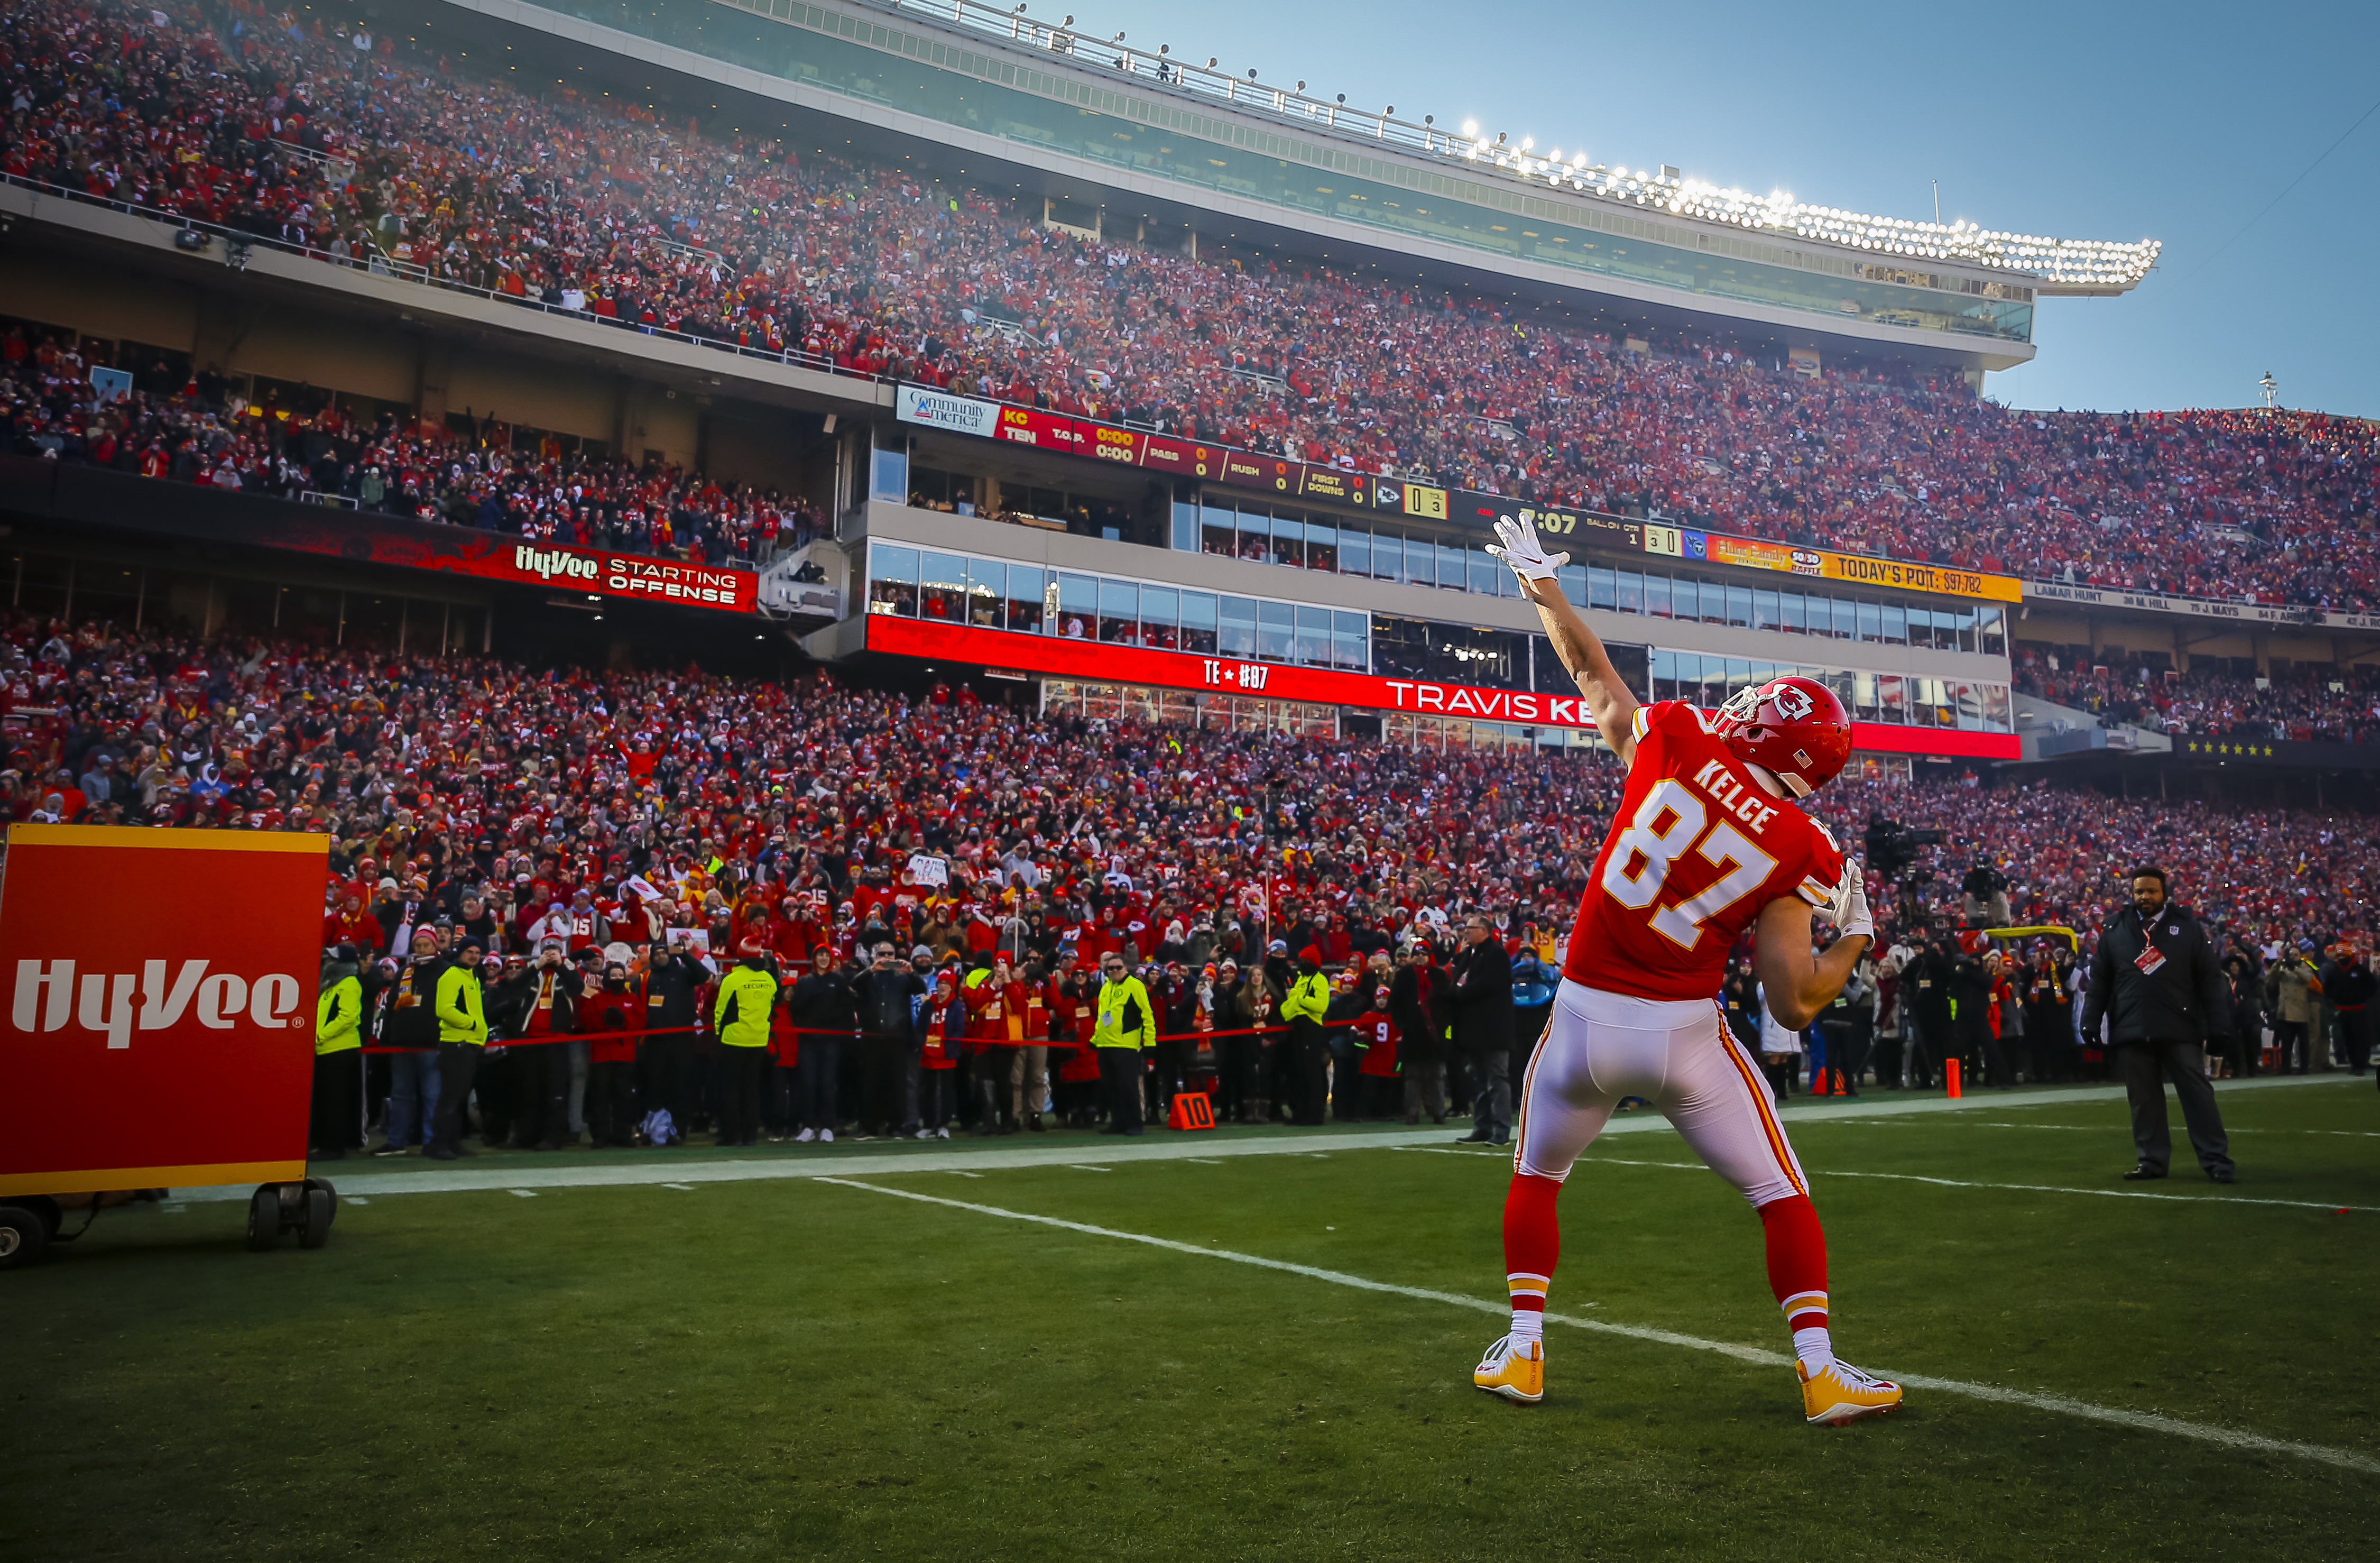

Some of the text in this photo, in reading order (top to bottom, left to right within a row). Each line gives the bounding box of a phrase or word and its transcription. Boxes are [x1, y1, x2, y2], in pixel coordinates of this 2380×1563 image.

[910, 391, 986, 421] Community
[1005, 410, 1028, 425] KC
[1004, 426, 1037, 444] TEN
[1096, 428, 1134, 446] 0:00
[1095, 444, 1133, 462] 0:00
[1150, 447, 1179, 461] PASS
[1196, 447, 1207, 460] 0
[1196, 463, 1207, 475] 0
[1231, 463, 1260, 476] RUSH
[1276, 462, 1287, 474] 0
[1276, 477, 1287, 490] 0
[1312, 473, 1341, 485] FIRST
[1353, 476, 1363, 488] 0
[1308, 482, 1344, 496] DOWNS
[1353, 491, 1363, 503] 0
[1433, 502, 1440, 511] 3
[1629, 534, 1637, 545] 1
[1651, 537, 1657, 547] 3
[610, 559, 736, 589] STARTING
[1838, 558, 1981, 593] TODAY'S POT: $97,782
[608, 575, 736, 604] OFFENSE
[2035, 585, 2102, 602] LAMAR HUNT
[2150, 598, 2170, 609] HILL
[2212, 605, 2238, 616] MAYS
[1203, 659, 1220, 684] TE
[1239, 664, 1268, 689] #87
[1386, 681, 1538, 719] TRAVIS
[1692, 758, 1779, 835] KELCE
[1601, 777, 1779, 952] 87
[1036, 867, 1053, 882] 15
[812, 889, 828, 905] 15
[571, 917, 591, 936] 15
[12, 959, 300, 1049] HyVee
[1377, 1022, 1388, 1042] 9
[1182, 1097, 1211, 1127] 10
